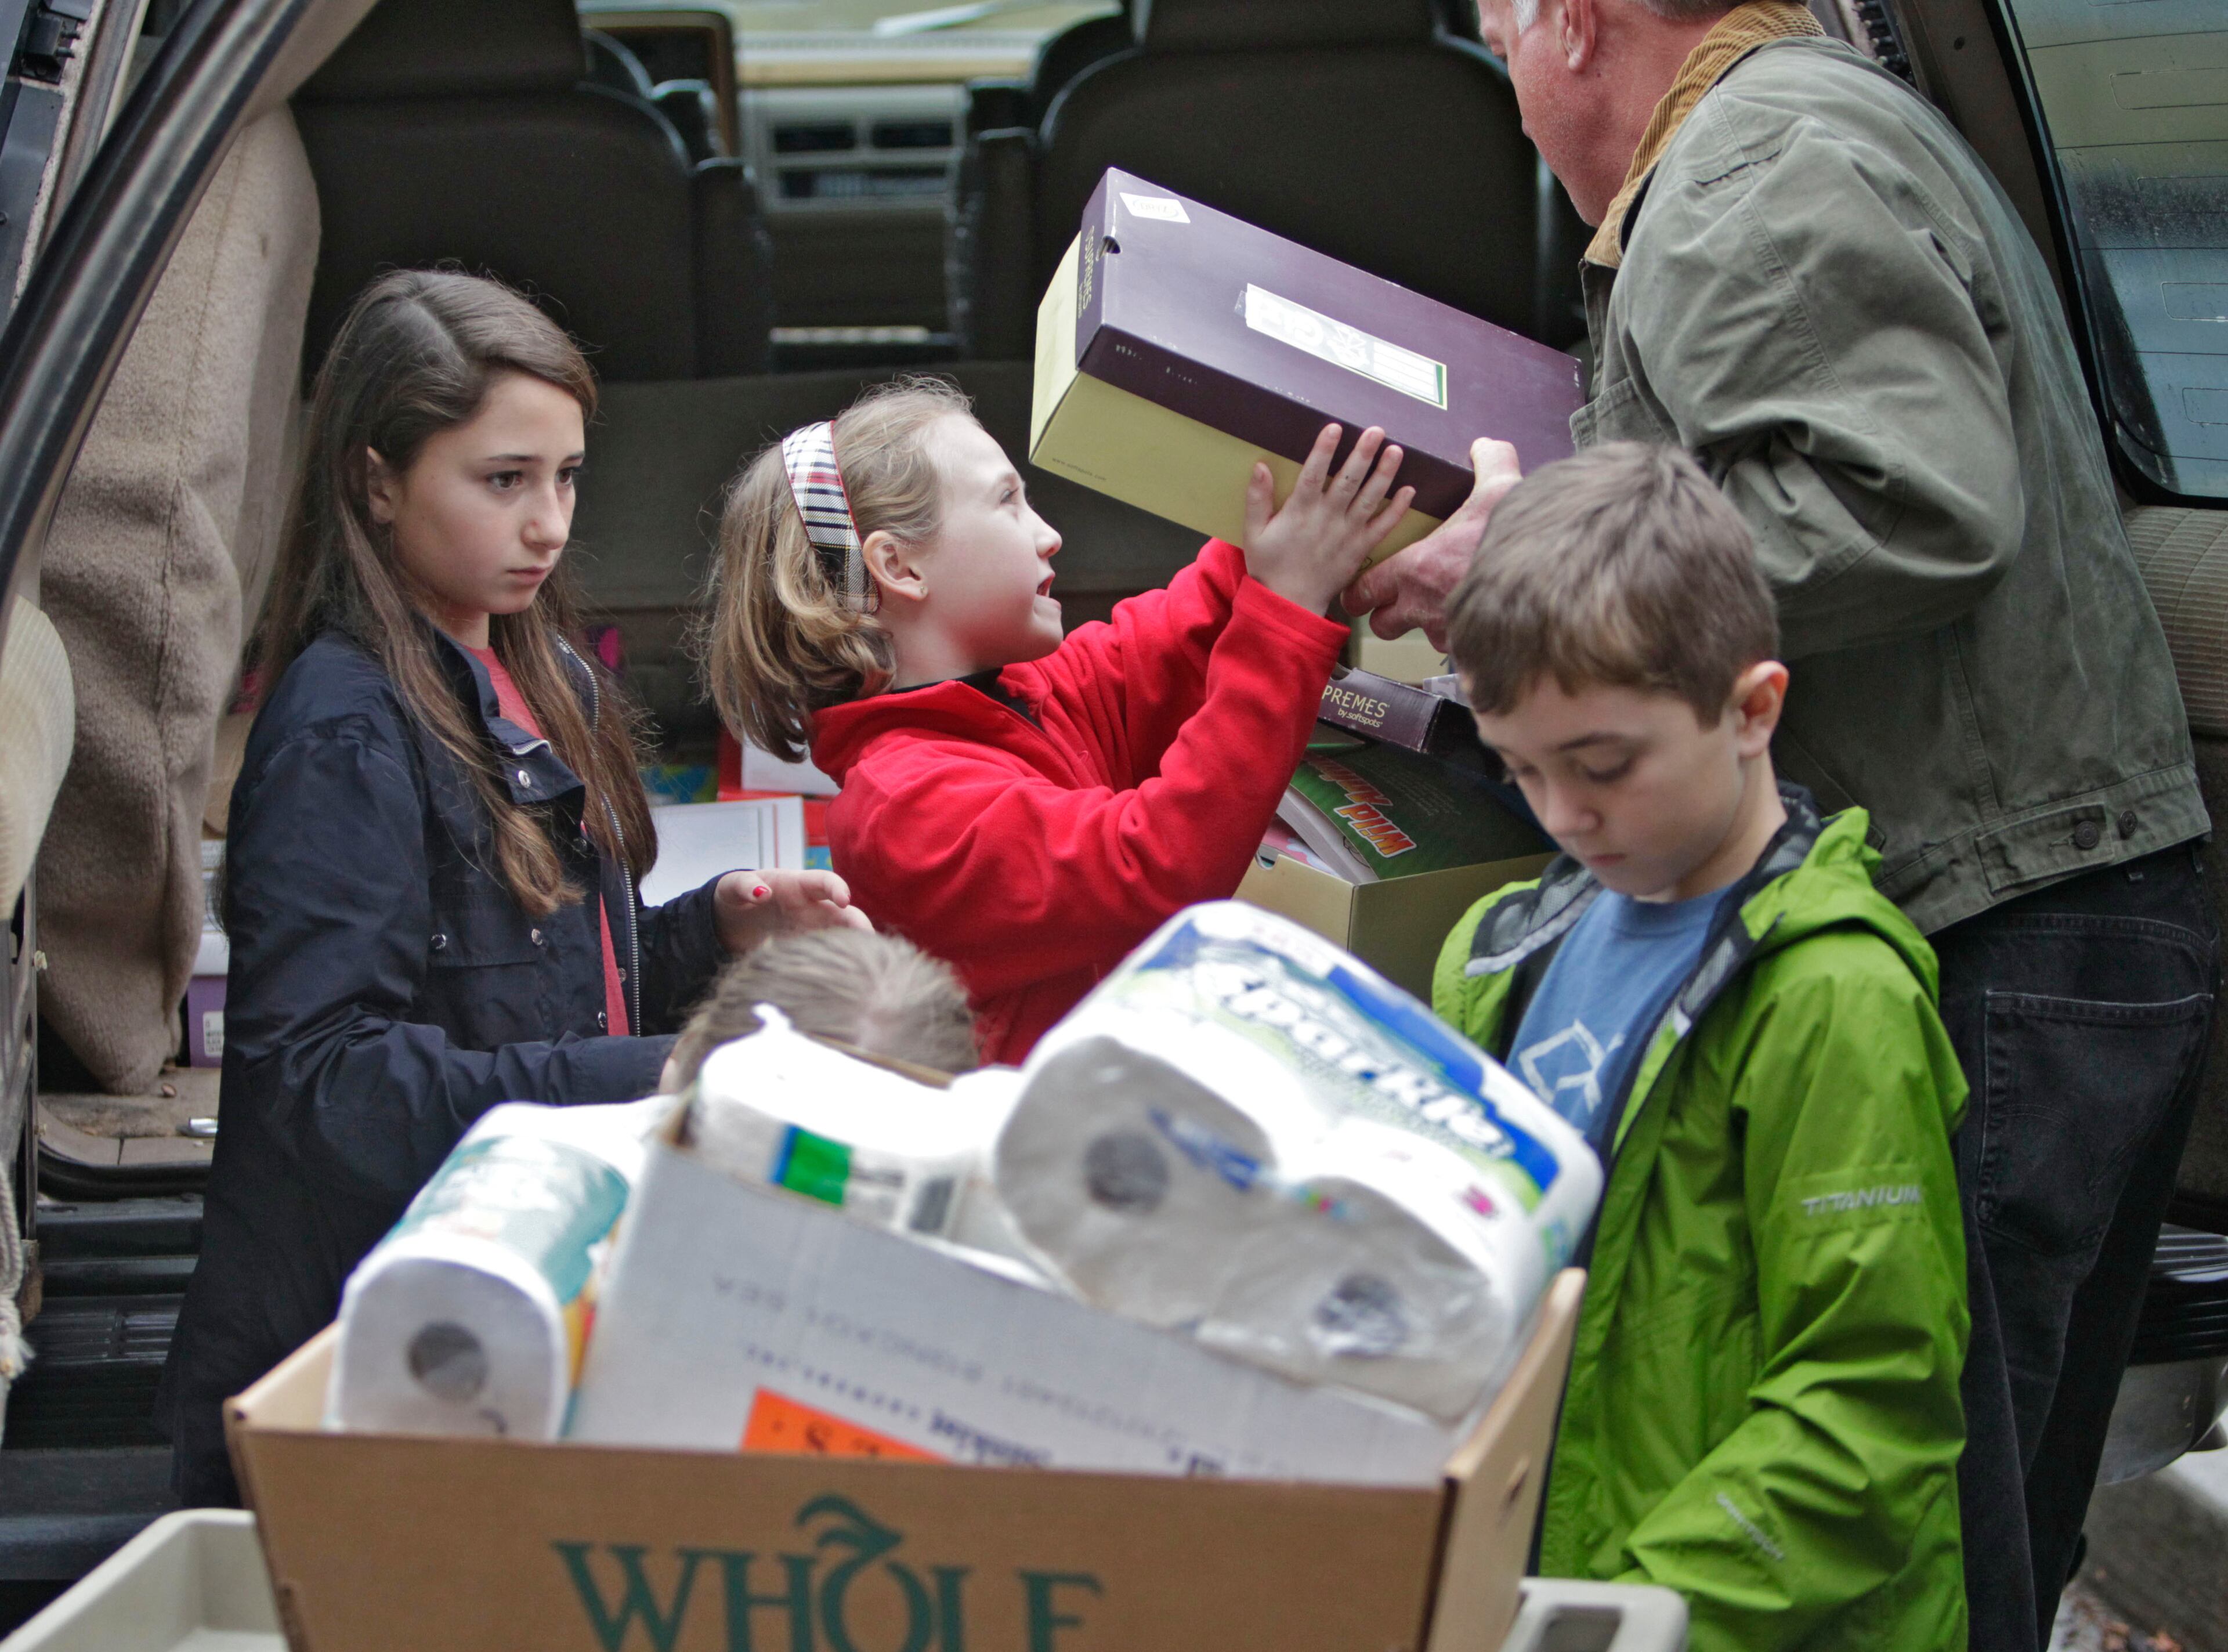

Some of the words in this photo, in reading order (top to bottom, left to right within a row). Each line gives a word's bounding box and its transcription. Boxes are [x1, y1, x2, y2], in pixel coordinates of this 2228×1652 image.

[1322, 685, 1388, 718] PREMES
[1337, 708, 1347, 718] by
[1346, 712, 1380, 728] softspots
[1334, 801, 1417, 858] Wild
[1801, 1185, 1920, 1216] TITANIUM
